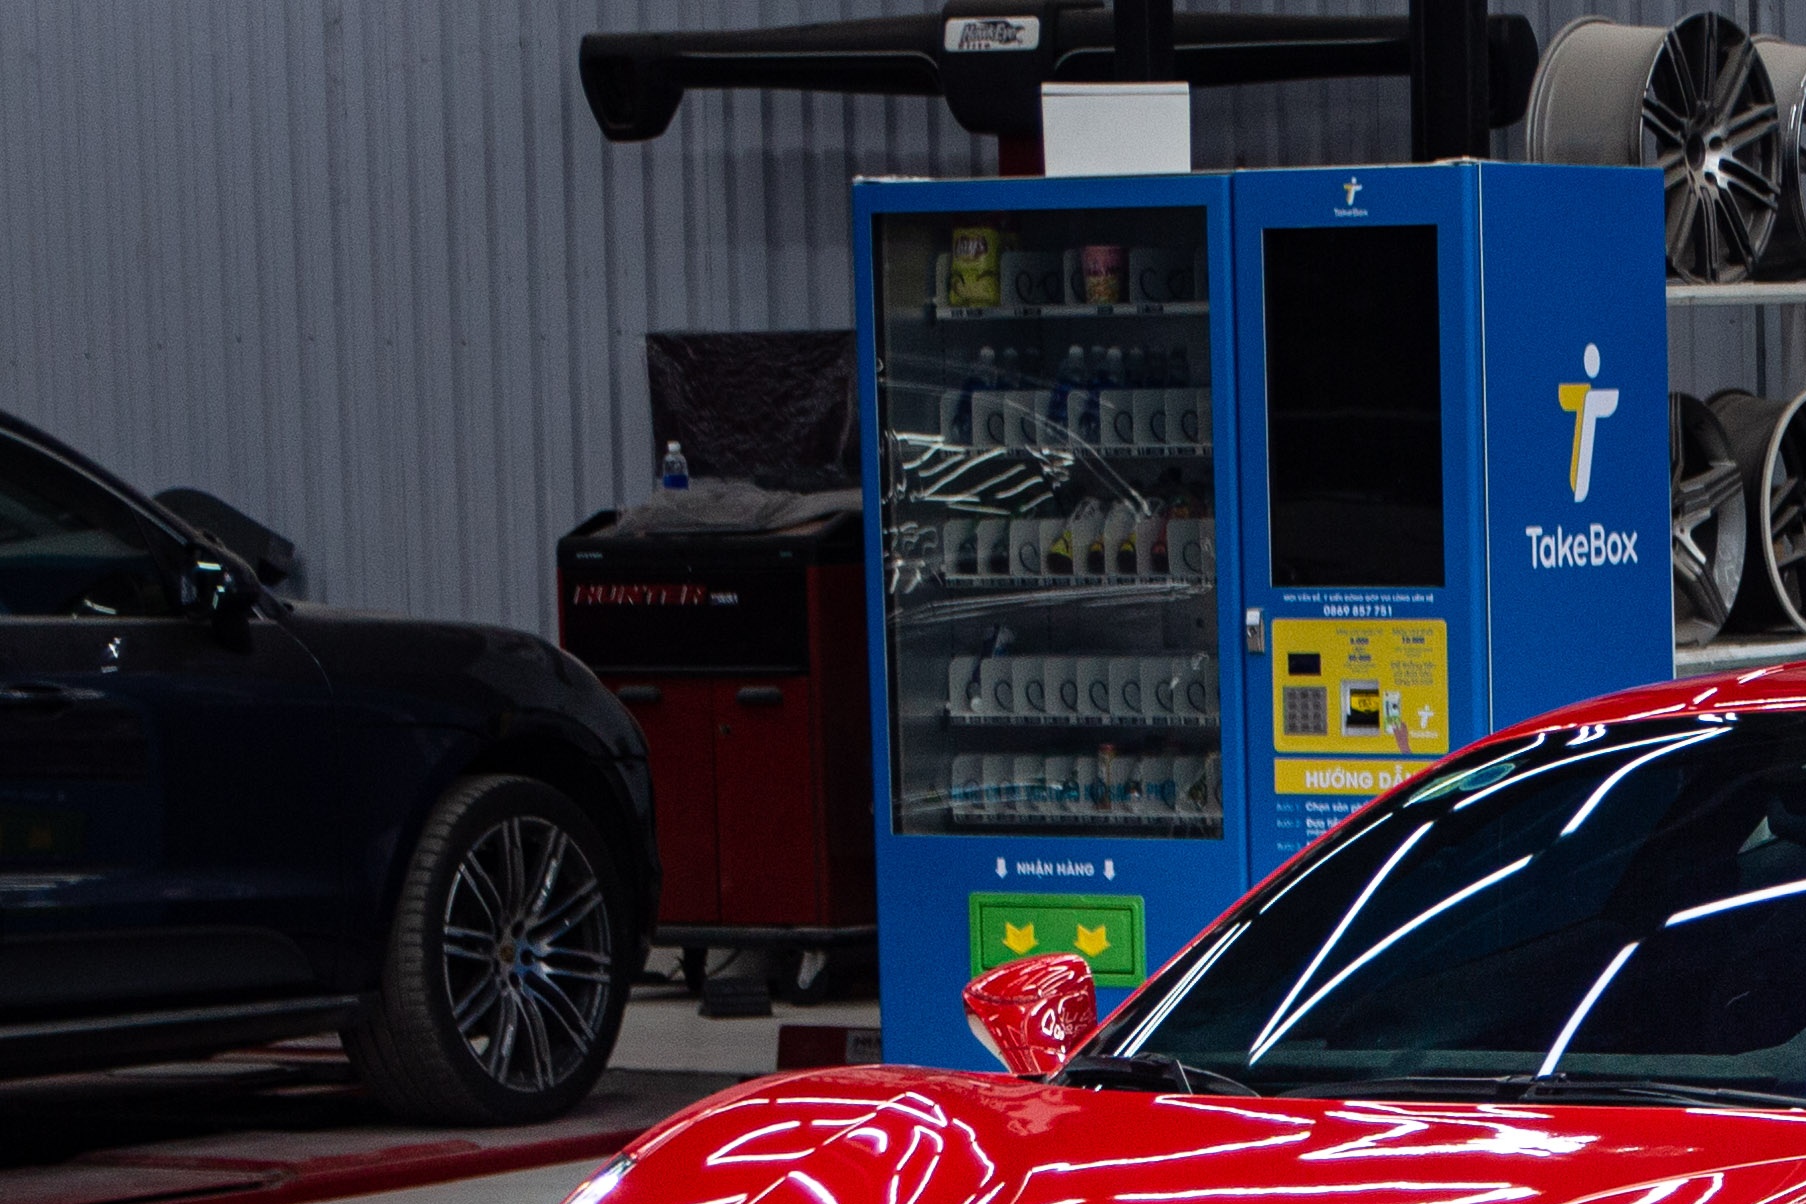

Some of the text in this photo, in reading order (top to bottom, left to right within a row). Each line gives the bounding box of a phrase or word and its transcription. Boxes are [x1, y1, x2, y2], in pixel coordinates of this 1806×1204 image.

[1525, 523, 1638, 569] TakeBox
[574, 584, 706, 605] HUNTER
[1323, 604, 1350, 617] 0869
[1305, 766, 1373, 789] HƯỚNG
[1016, 858, 1095, 879] NHẬN HÀNG
